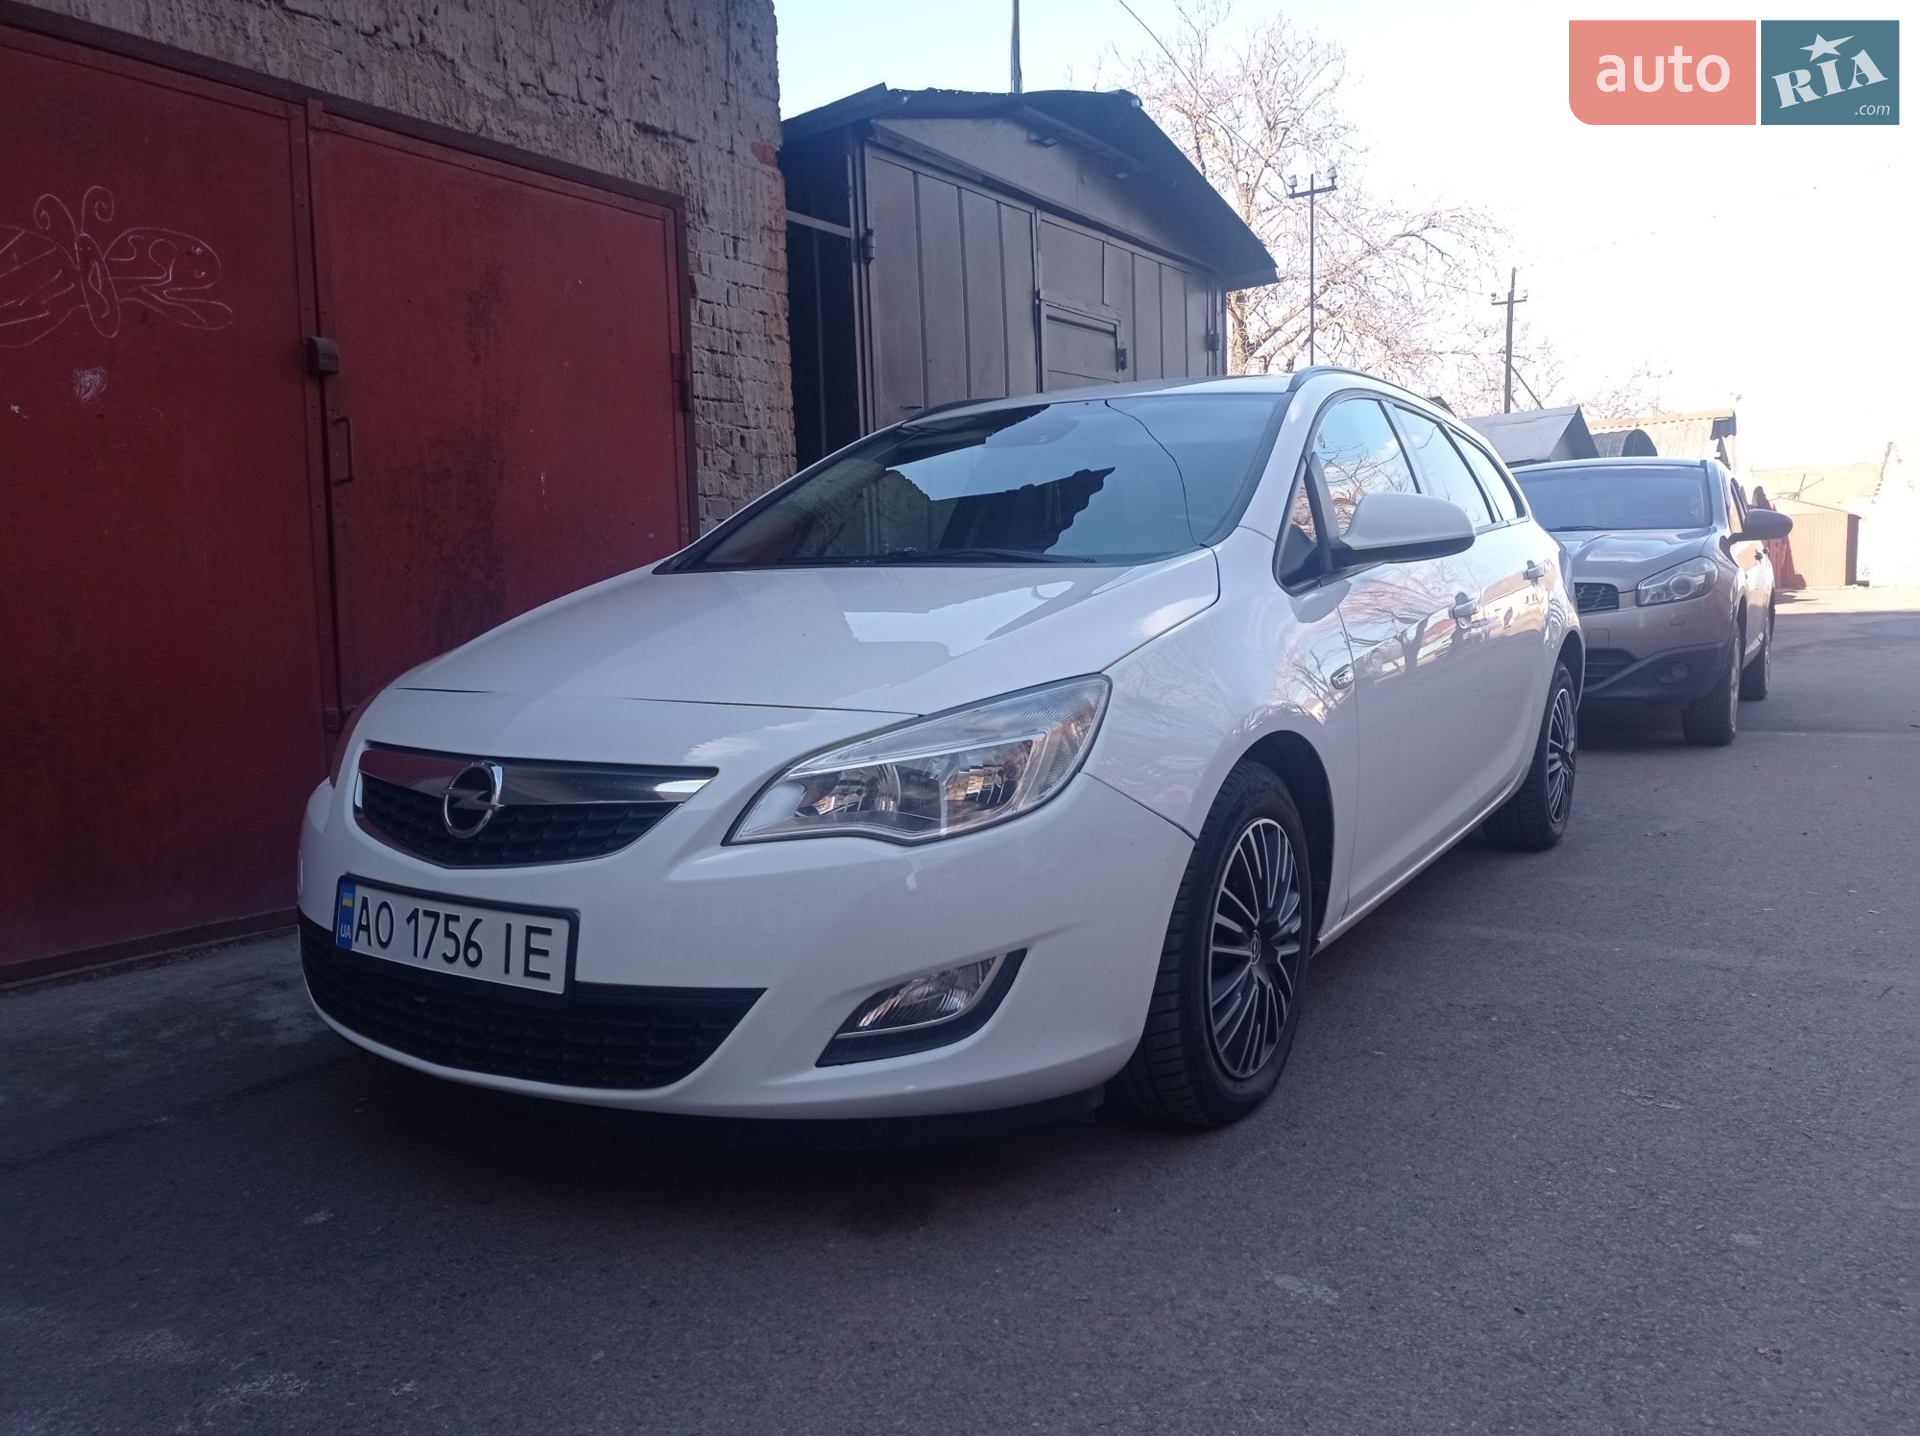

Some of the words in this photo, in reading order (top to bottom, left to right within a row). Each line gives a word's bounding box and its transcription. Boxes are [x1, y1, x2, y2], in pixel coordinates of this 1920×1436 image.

[340, 923, 352, 939] UA
[355, 896, 394, 949] AO
[406, 907, 483, 968] 1756
[504, 922, 553, 980] IE
